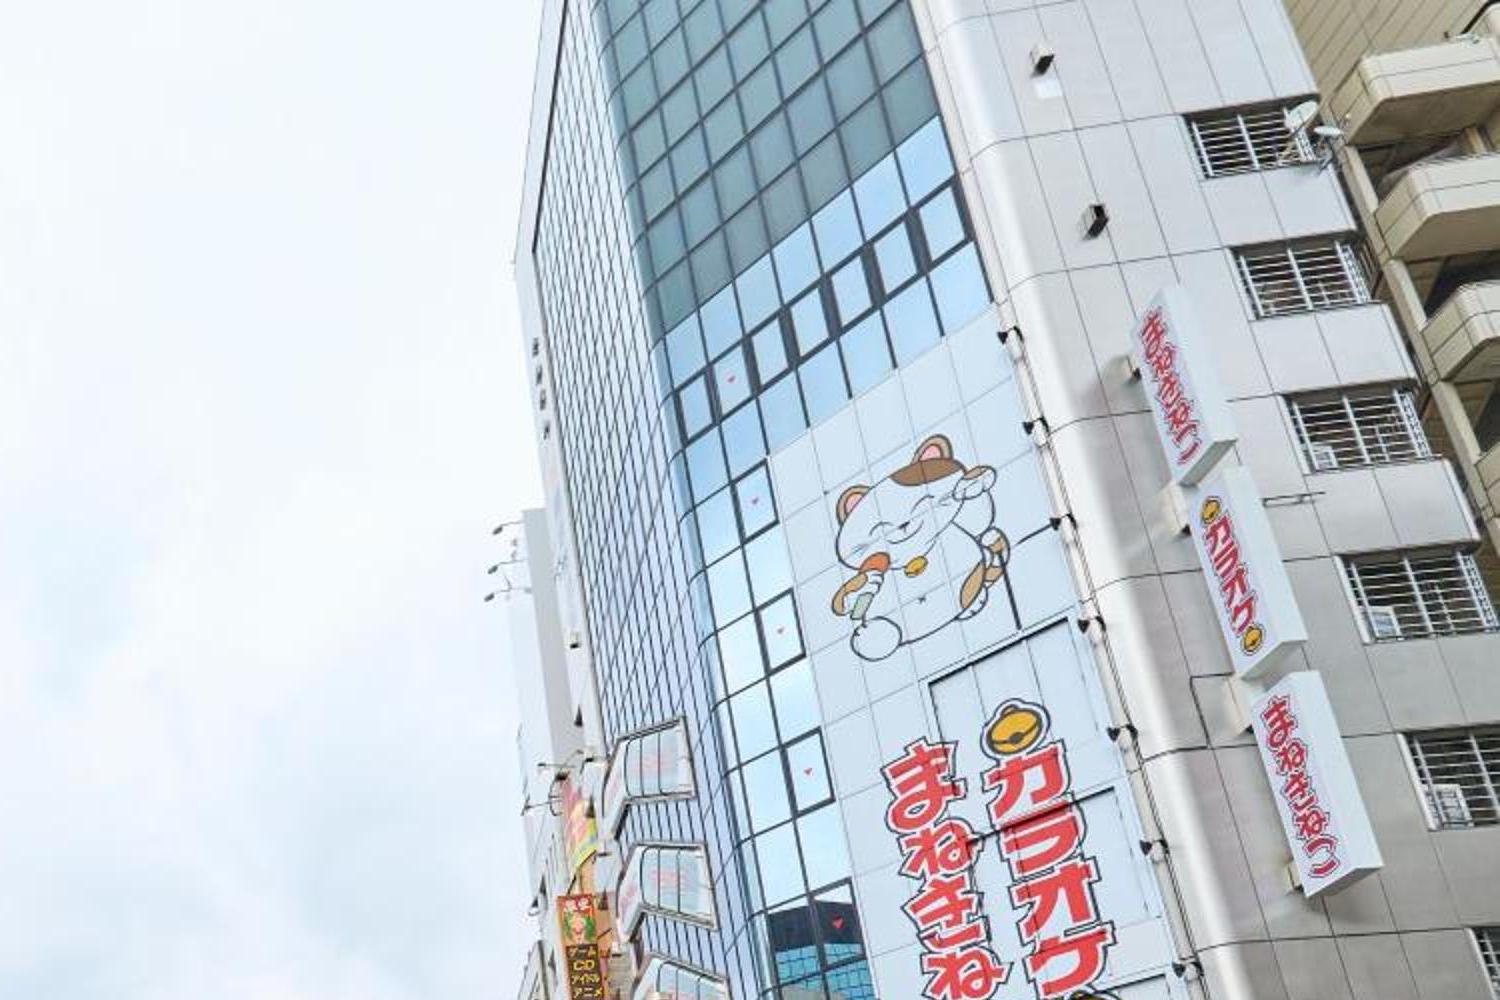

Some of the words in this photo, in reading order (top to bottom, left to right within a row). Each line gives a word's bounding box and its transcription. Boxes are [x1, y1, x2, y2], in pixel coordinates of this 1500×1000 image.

[1139, 306, 1202, 464] まねきねこ
[1203, 510, 1257, 637] カラオケ
[1260, 695, 1341, 878] まねきねこ
